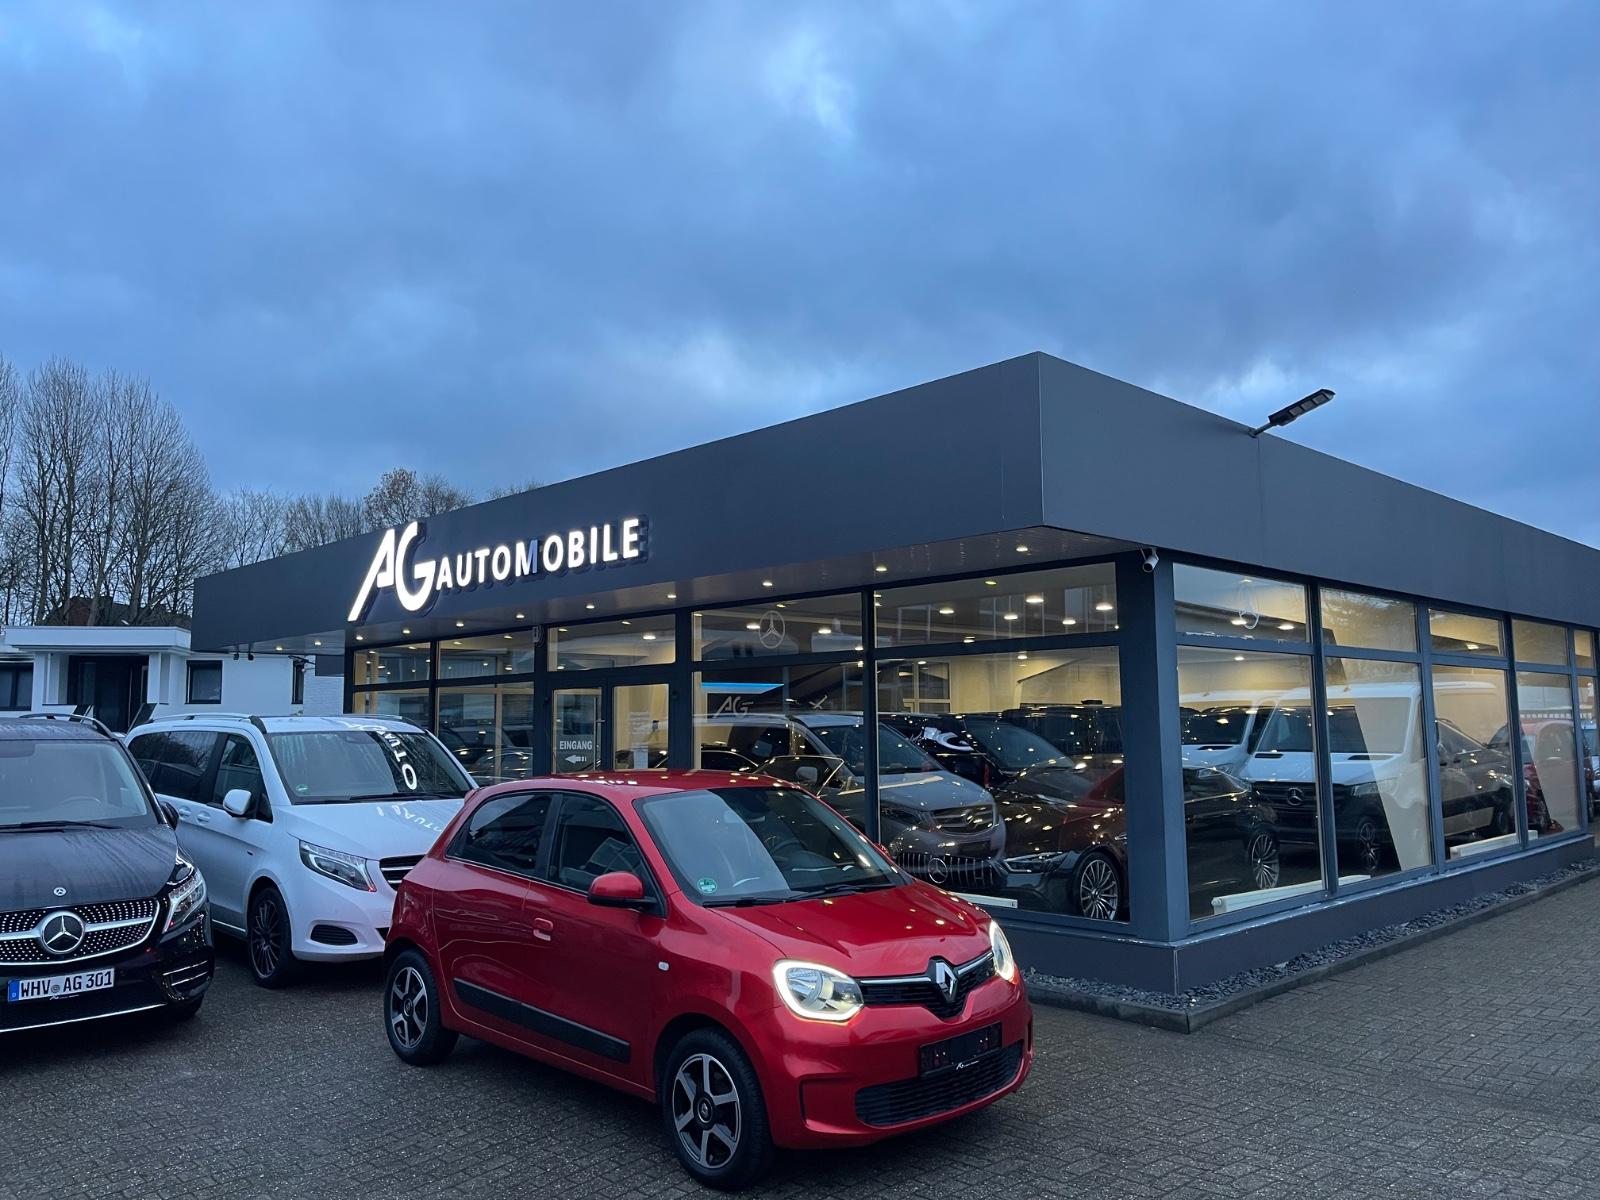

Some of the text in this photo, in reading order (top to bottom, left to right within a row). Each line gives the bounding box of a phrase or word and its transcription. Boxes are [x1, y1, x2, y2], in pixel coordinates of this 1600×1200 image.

[347, 518, 639, 622] AG AUTOMOBILE
[559, 740, 593, 750] EINGANG
[20, 970, 113, 998] WHV AG 301
